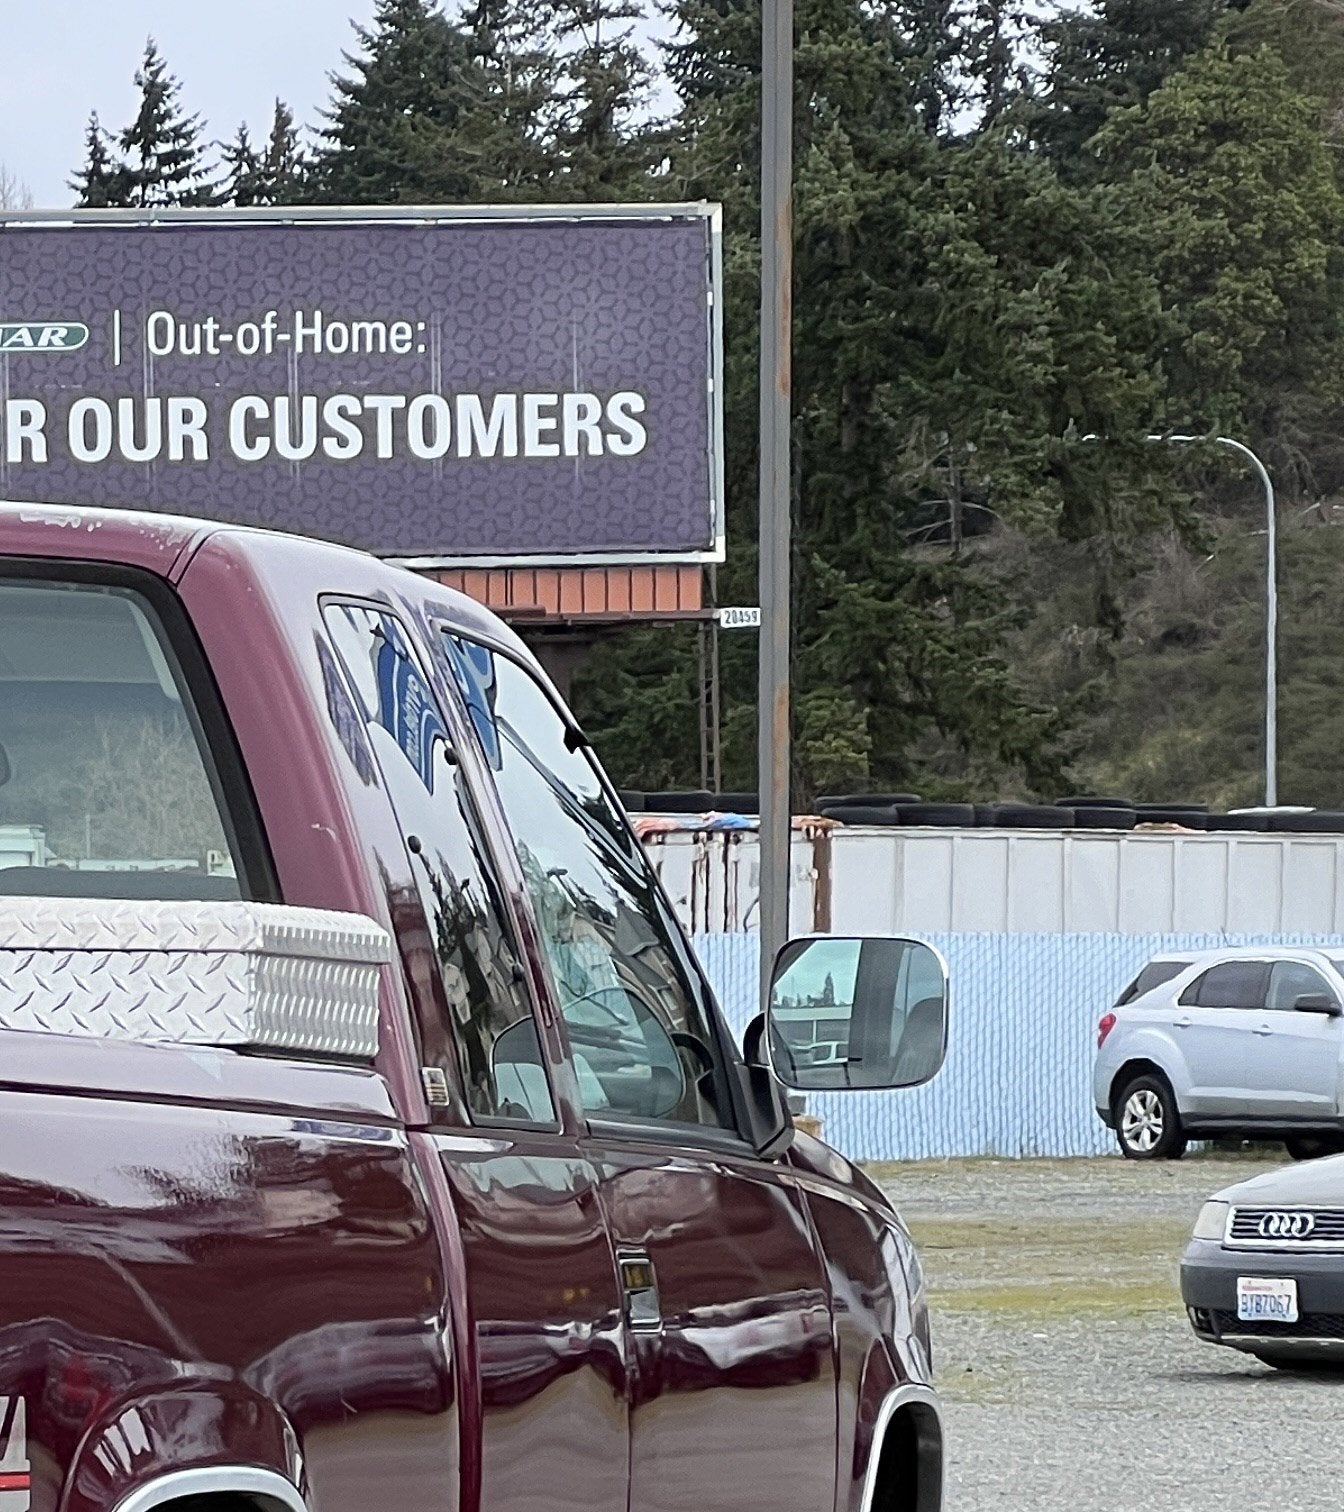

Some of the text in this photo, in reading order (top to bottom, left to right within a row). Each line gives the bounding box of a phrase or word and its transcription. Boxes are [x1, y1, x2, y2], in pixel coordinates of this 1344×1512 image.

[147, 311, 427, 354] Out-of-Home:
[68, 396, 208, 463] OUR
[228, 391, 647, 460] CUSTOMERS
